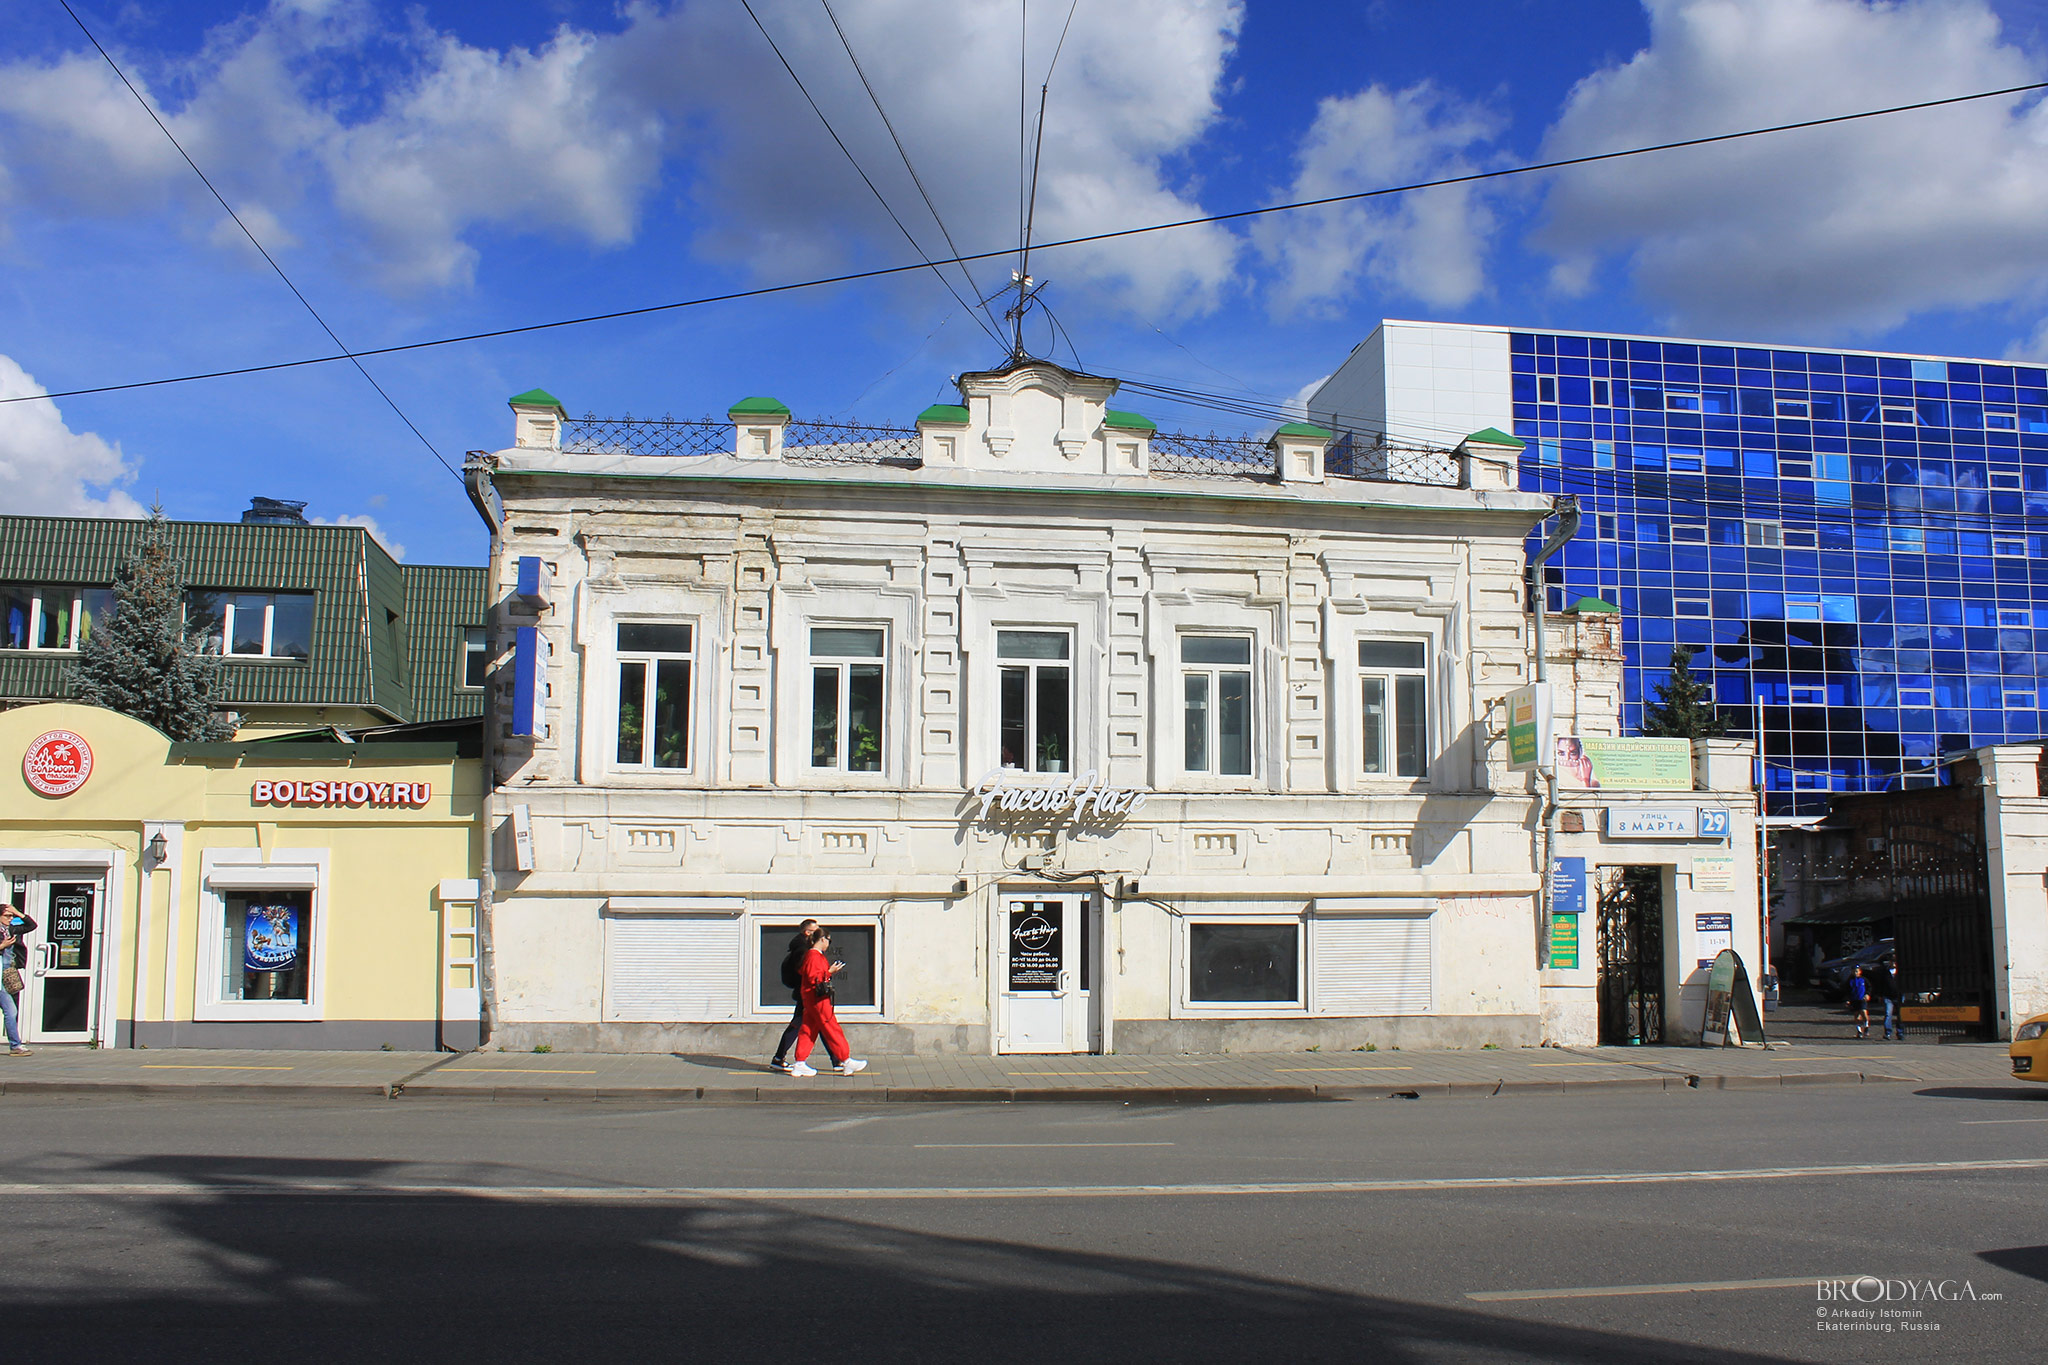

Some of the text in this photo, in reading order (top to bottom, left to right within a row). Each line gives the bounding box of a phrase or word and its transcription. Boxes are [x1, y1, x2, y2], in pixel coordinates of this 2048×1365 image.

[1585, 741, 1687, 753] МАГАЗИН ИНДИЙСКИХ ТОВАРОВ
[30, 762, 75, 773] БОЛЬШОЙ
[254, 780, 431, 804] BOLSHOY.RU
[1067, 769, 1149, 823] Haze
[1619, 822, 1685, 831] 8 МАРТА
[1703, 813, 1725, 832] 29
[59, 907, 83, 918] 10:00
[57, 920, 82, 931] 20:00
